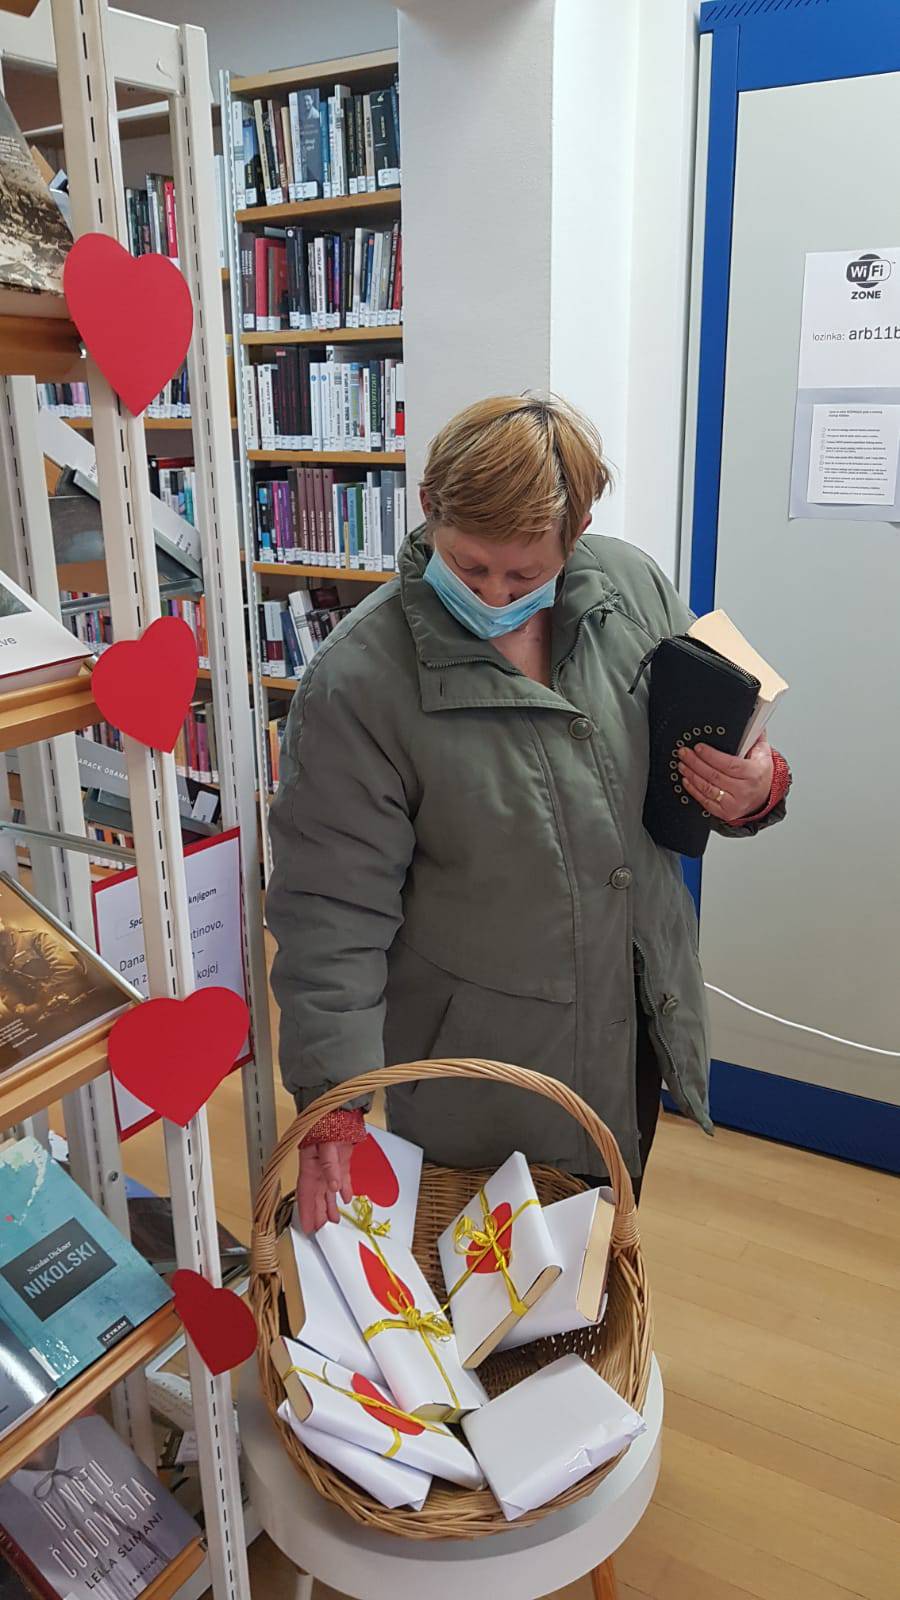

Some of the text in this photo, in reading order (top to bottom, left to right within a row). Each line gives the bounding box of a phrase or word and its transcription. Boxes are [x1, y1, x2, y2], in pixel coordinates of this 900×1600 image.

[850, 290, 882, 300] ZONE
[813, 332, 845, 341] lozinka:
[188, 888, 217, 904] knjigom
[197, 962, 219, 979] kojoj
[23, 1241, 97, 1299] NIKOLSKI
[102, 1320, 127, 1342] LEYKAM
[41, 1460, 114, 1530] U VRTU
[49, 1477, 156, 1579] ČUDOVIŠTA
[117, 1512, 163, 1559] SLIMANI
